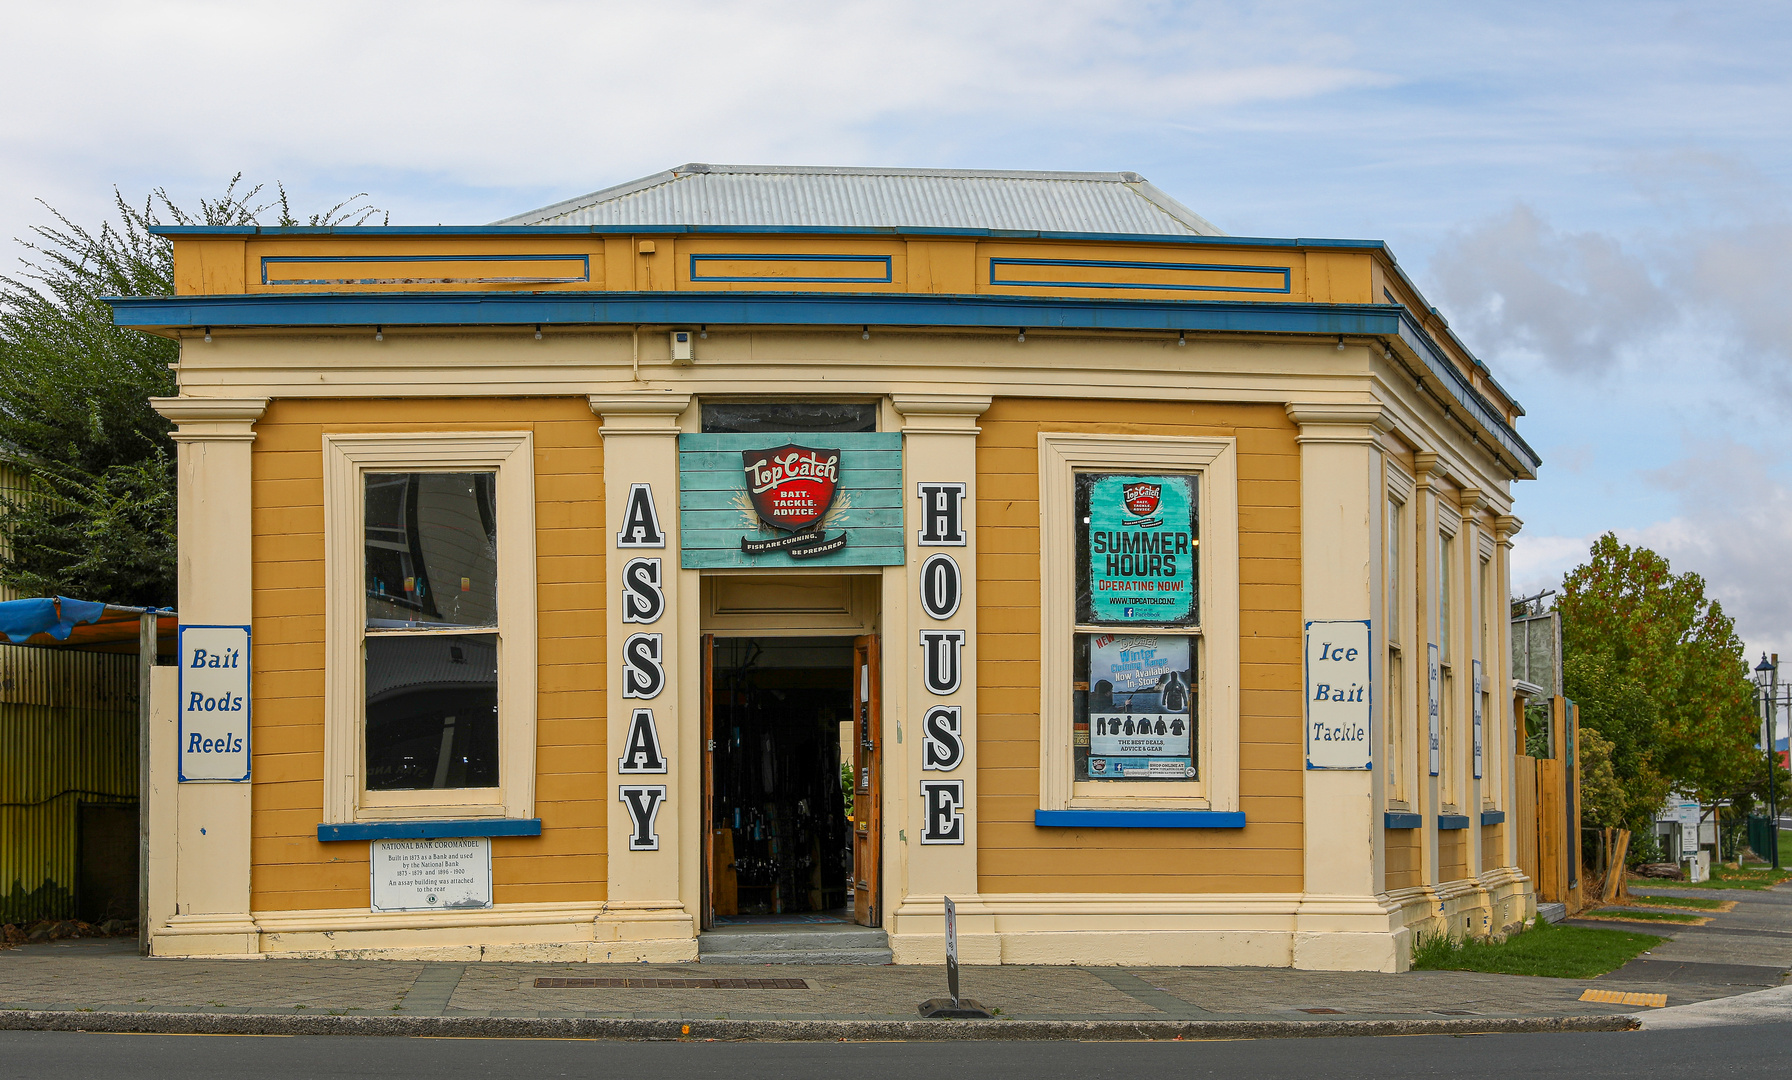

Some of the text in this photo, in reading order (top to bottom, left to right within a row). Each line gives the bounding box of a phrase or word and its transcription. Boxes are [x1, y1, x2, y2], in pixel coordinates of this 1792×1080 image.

[744, 452, 838, 488] Top Catch
[1124, 486, 1160, 500] Top Catch
[765, 541, 781, 549] ARE
[782, 533, 818, 546] CUNNING.
[803, 540, 844, 555] PREPARED.
[1094, 532, 1188, 554] SUMMER
[1106, 554, 1176, 576] HOURS
[1099, 580, 1184, 591] OPERATING NOW!
[1095, 634, 1115, 649] NEW
[190, 647, 239, 668] Bait
[1120, 649, 1157, 662] Winter
[1319, 642, 1358, 662] Ice
[1144, 658, 1168, 667] Range
[1115, 666, 1170, 682] Now Available
[1127, 677, 1159, 688] In-Store
[1313, 683, 1364, 702] Bait
[187, 692, 243, 712] Rods
[1313, 722, 1364, 741] Tackle
[187, 732, 243, 753] Reels
[381, 842, 414, 850] NATIONAL
[435, 840, 479, 848] COROMANDEL
